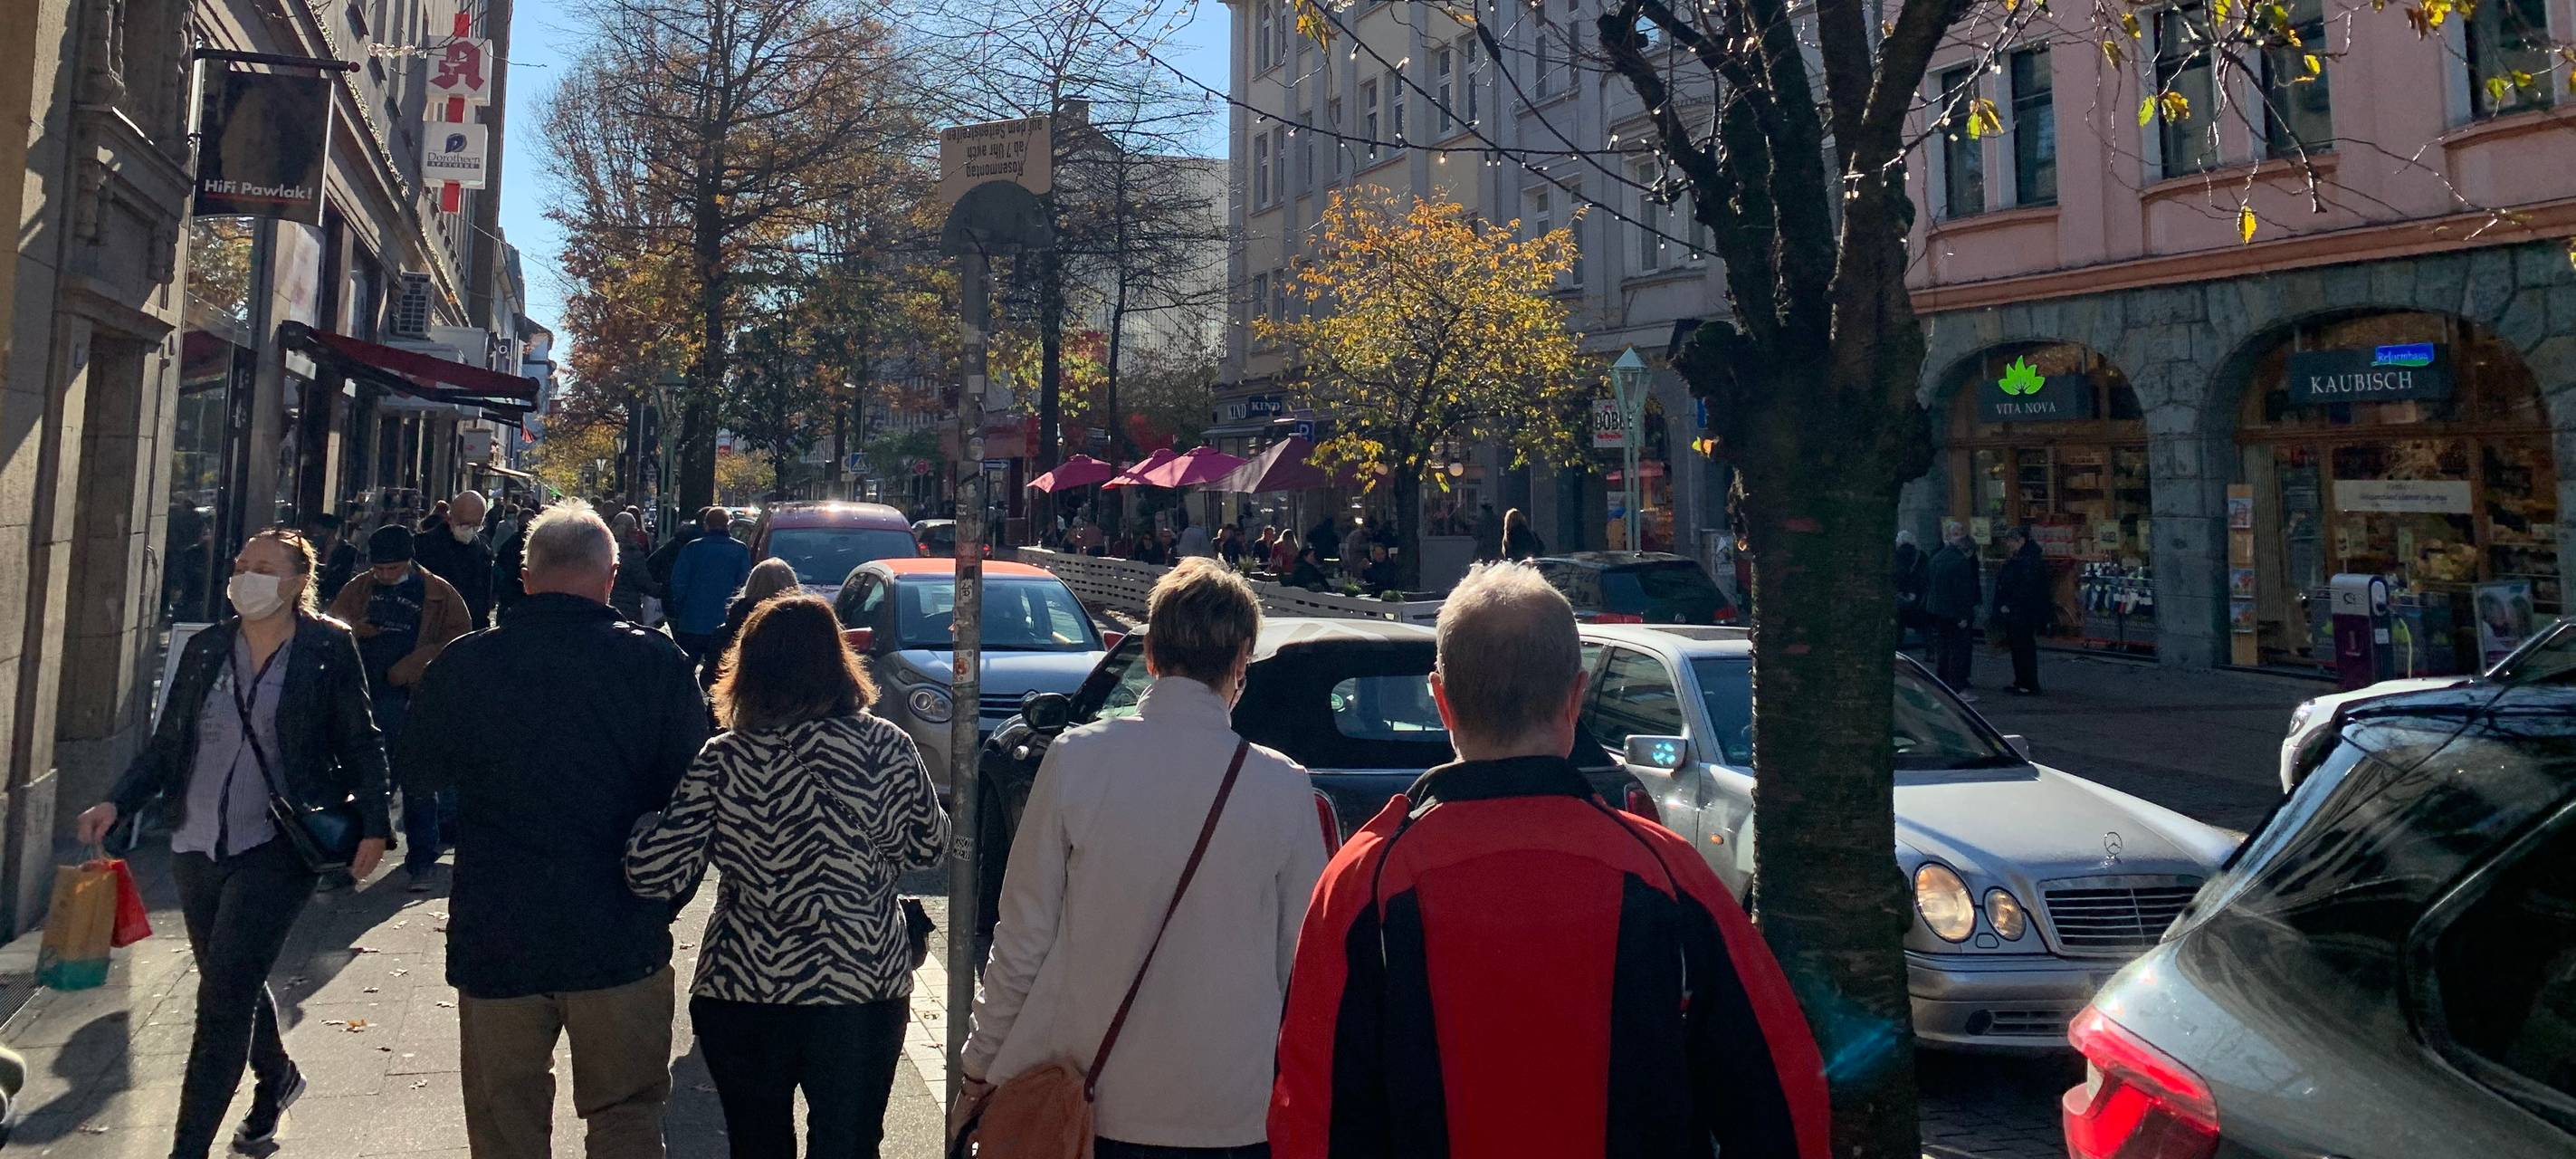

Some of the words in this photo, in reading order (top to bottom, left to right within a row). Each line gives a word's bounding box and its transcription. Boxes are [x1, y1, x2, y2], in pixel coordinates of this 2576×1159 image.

[946, 125, 1006, 143] Seitenstreifen
[1008, 122, 1026, 136] dem
[1028, 119, 1043, 134] auf
[967, 146, 987, 158] auch
[989, 144, 1004, 159] Uhr
[1007, 143, 1013, 158] 7
[1014, 141, 1025, 157] ab
[427, 151, 481, 164] Dorotheen
[966, 161, 1023, 178] Rosenmontag
[205, 178, 237, 194] HiFi
[241, 181, 313, 200] Pawlak!
[2310, 370, 2413, 394] KAUBISCH
[1227, 403, 1247, 420] KIND
[1251, 401, 1282, 412] KIND
[1996, 403, 2021, 415] VITA
[2025, 401, 2056, 414] NOVA
